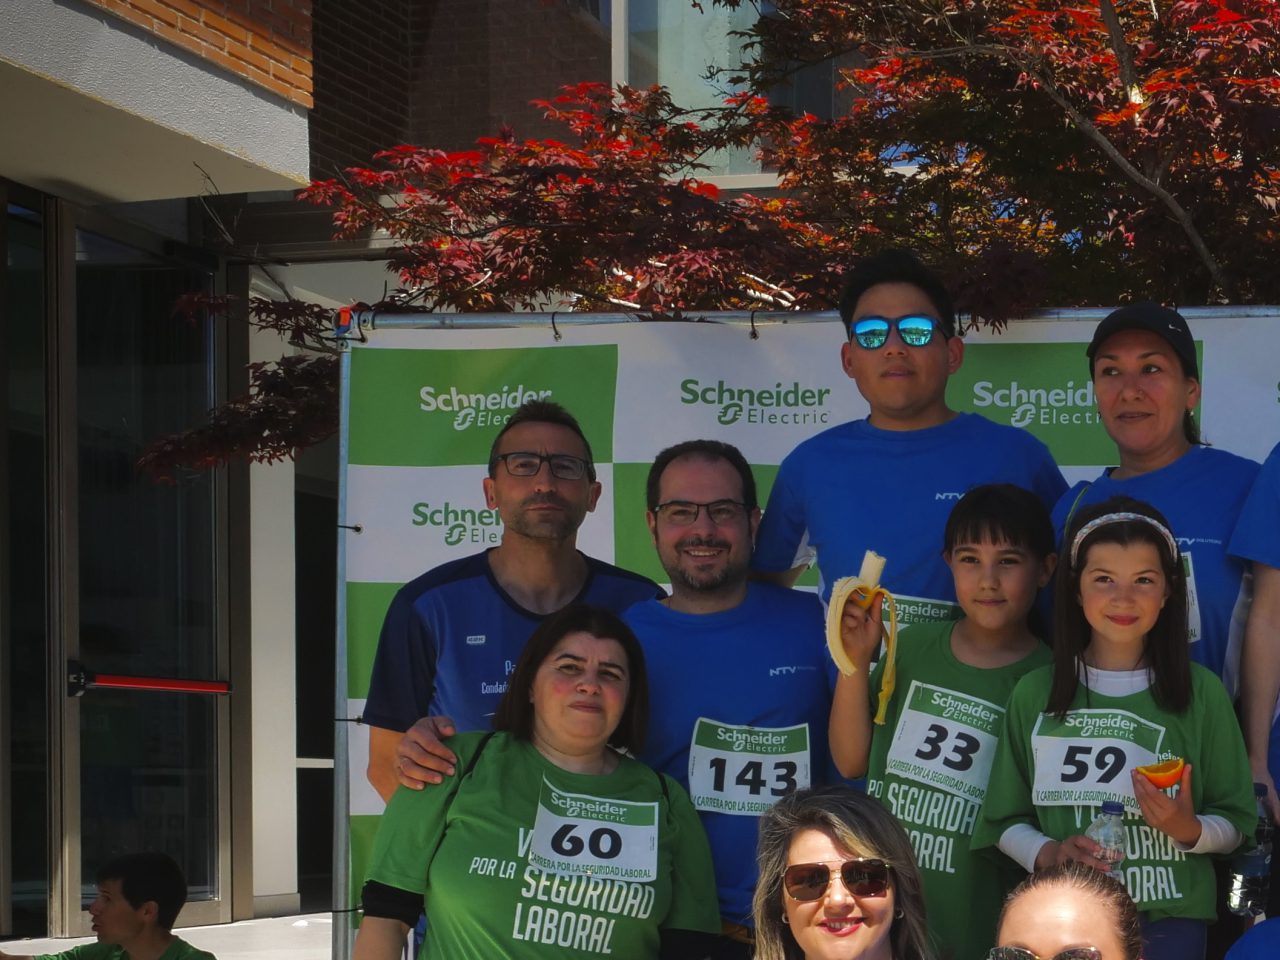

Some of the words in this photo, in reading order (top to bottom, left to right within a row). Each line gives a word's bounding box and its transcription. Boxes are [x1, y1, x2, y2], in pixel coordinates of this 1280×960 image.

[681, 378, 831, 407] Schneider
[973, 380, 1098, 407] Schneid
[477, 411, 511, 427] Elec
[747, 408, 829, 425] Electric
[1040, 408, 1100, 425] Electr
[935, 492, 966, 500] NTV
[412, 502, 500, 526] Schnei
[1175, 537, 1195, 545] TV
[769, 666, 796, 677] NTV
[931, 691, 999, 723] Schneider
[953, 711, 993, 731] Electric
[1064, 714, 1138, 731] Schneider
[717, 727, 788, 745] Schneider
[1093, 727, 1135, 740] Electric
[746, 742, 786, 753] Electric
[914, 723, 981, 772] 33
[1060, 745, 1127, 784] 59
[709, 757, 798, 797] 143
[922, 768, 930, 779] LA
[930, 771, 964, 790] SEGURIDAD
[963, 783, 985, 799] LABOR
[551, 792, 628, 815] Schneider
[697, 795, 724, 809] CARRERA
[724, 800, 737, 810] POR
[737, 801, 746, 811] LA
[1040, 790, 1062, 802] CARRERA
[1061, 790, 1074, 801] POR
[1074, 790, 1081, 802] LA
[581, 810, 625, 823] Electric
[887, 782, 981, 835] SEGURIDA
[550, 823, 623, 860] 60
[469, 856, 496, 876] POR
[500, 860, 517, 880] LA
[557, 860, 571, 872] POR
[571, 864, 581, 873] LA
[620, 868, 652, 878] LABORAL
[521, 865, 656, 920] SEGURIDAD
[1122, 866, 1183, 904] ORAL
[512, 902, 616, 954] LABORAL
